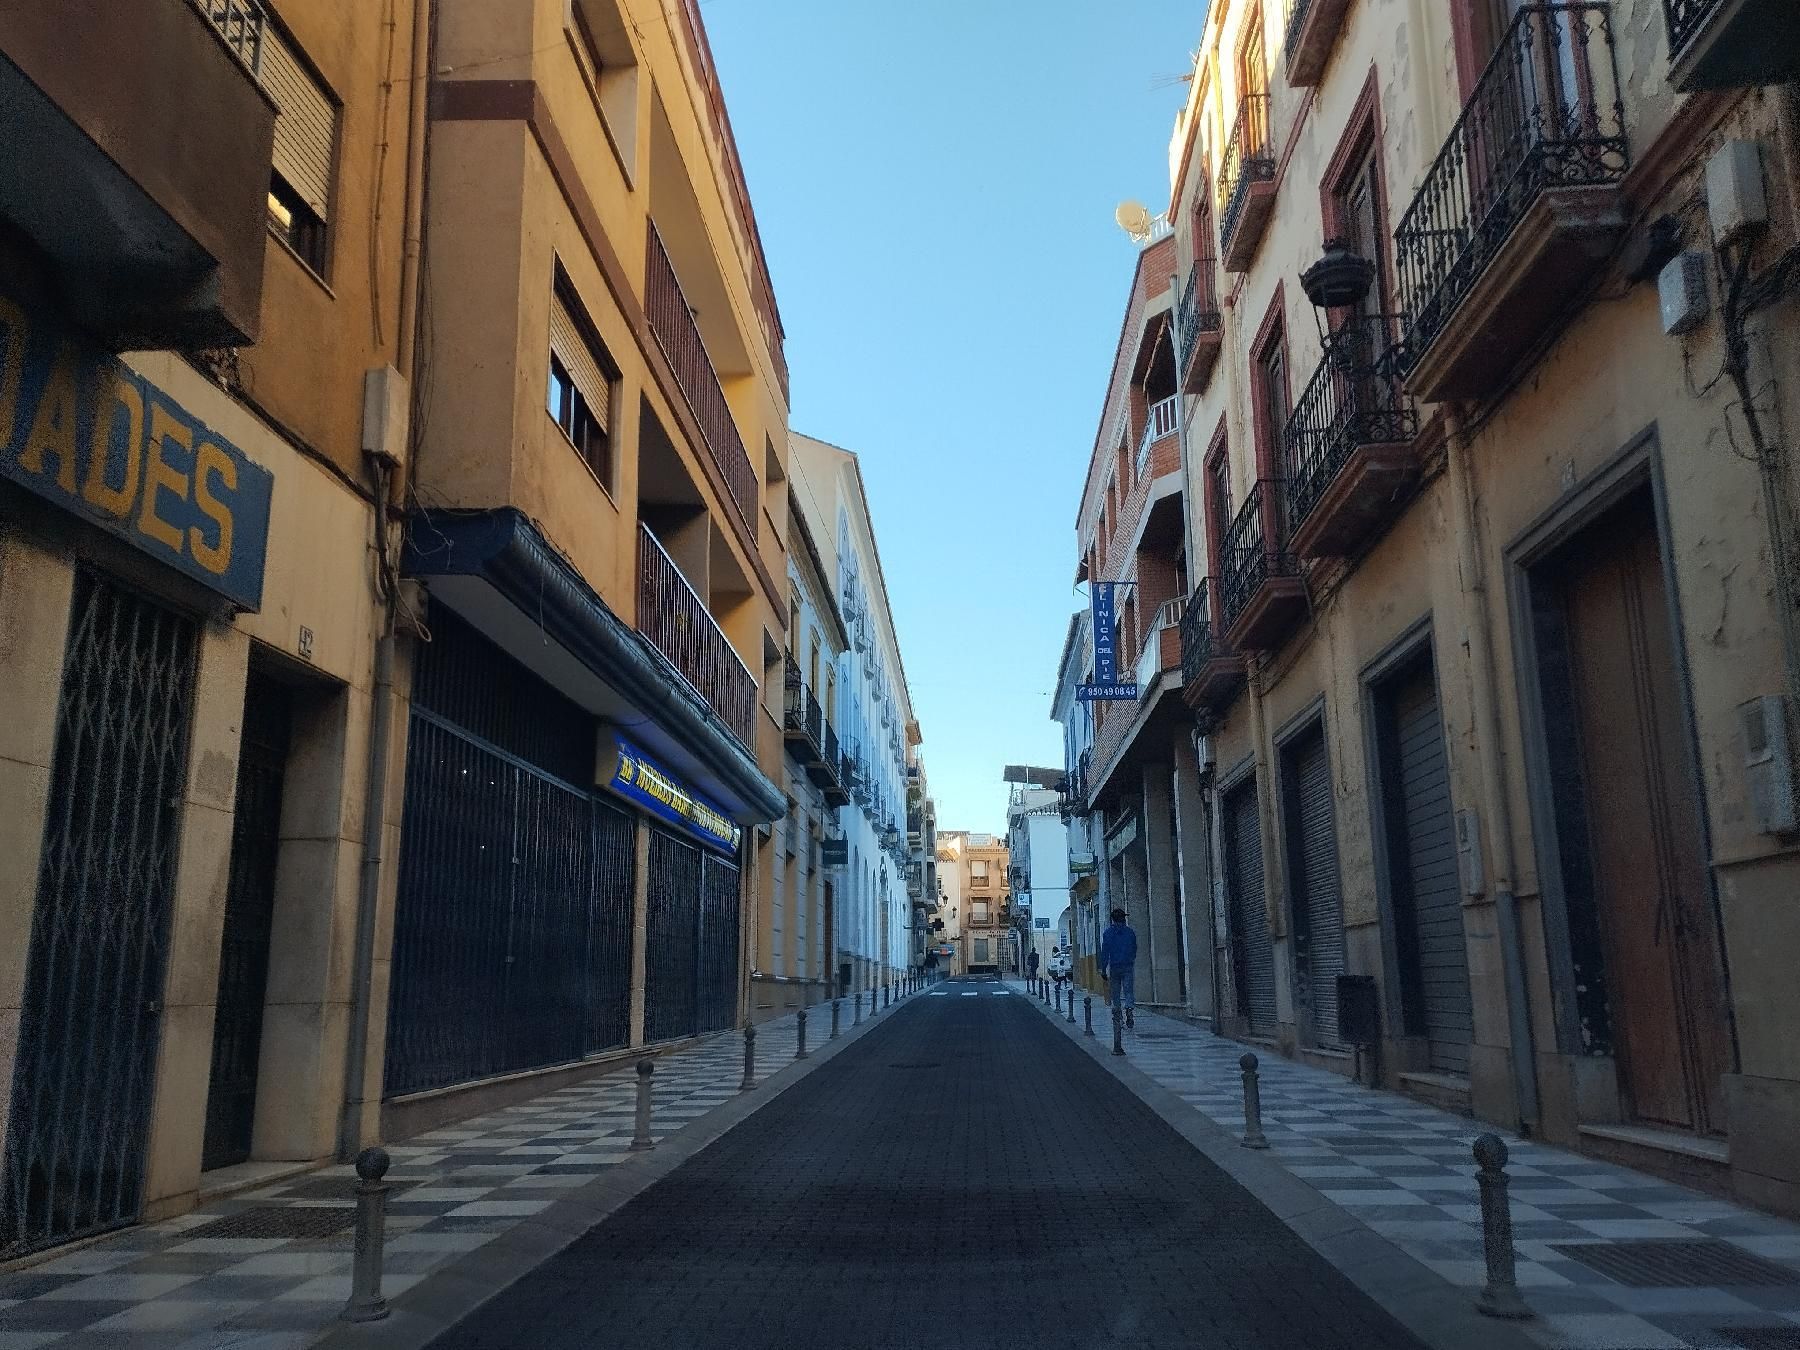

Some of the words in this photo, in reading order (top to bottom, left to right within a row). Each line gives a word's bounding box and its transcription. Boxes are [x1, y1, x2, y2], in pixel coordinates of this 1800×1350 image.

[1101, 659, 1111, 680] PIE
[1087, 686, 1103, 697] 950
[1103, 687, 1114, 696] 49
